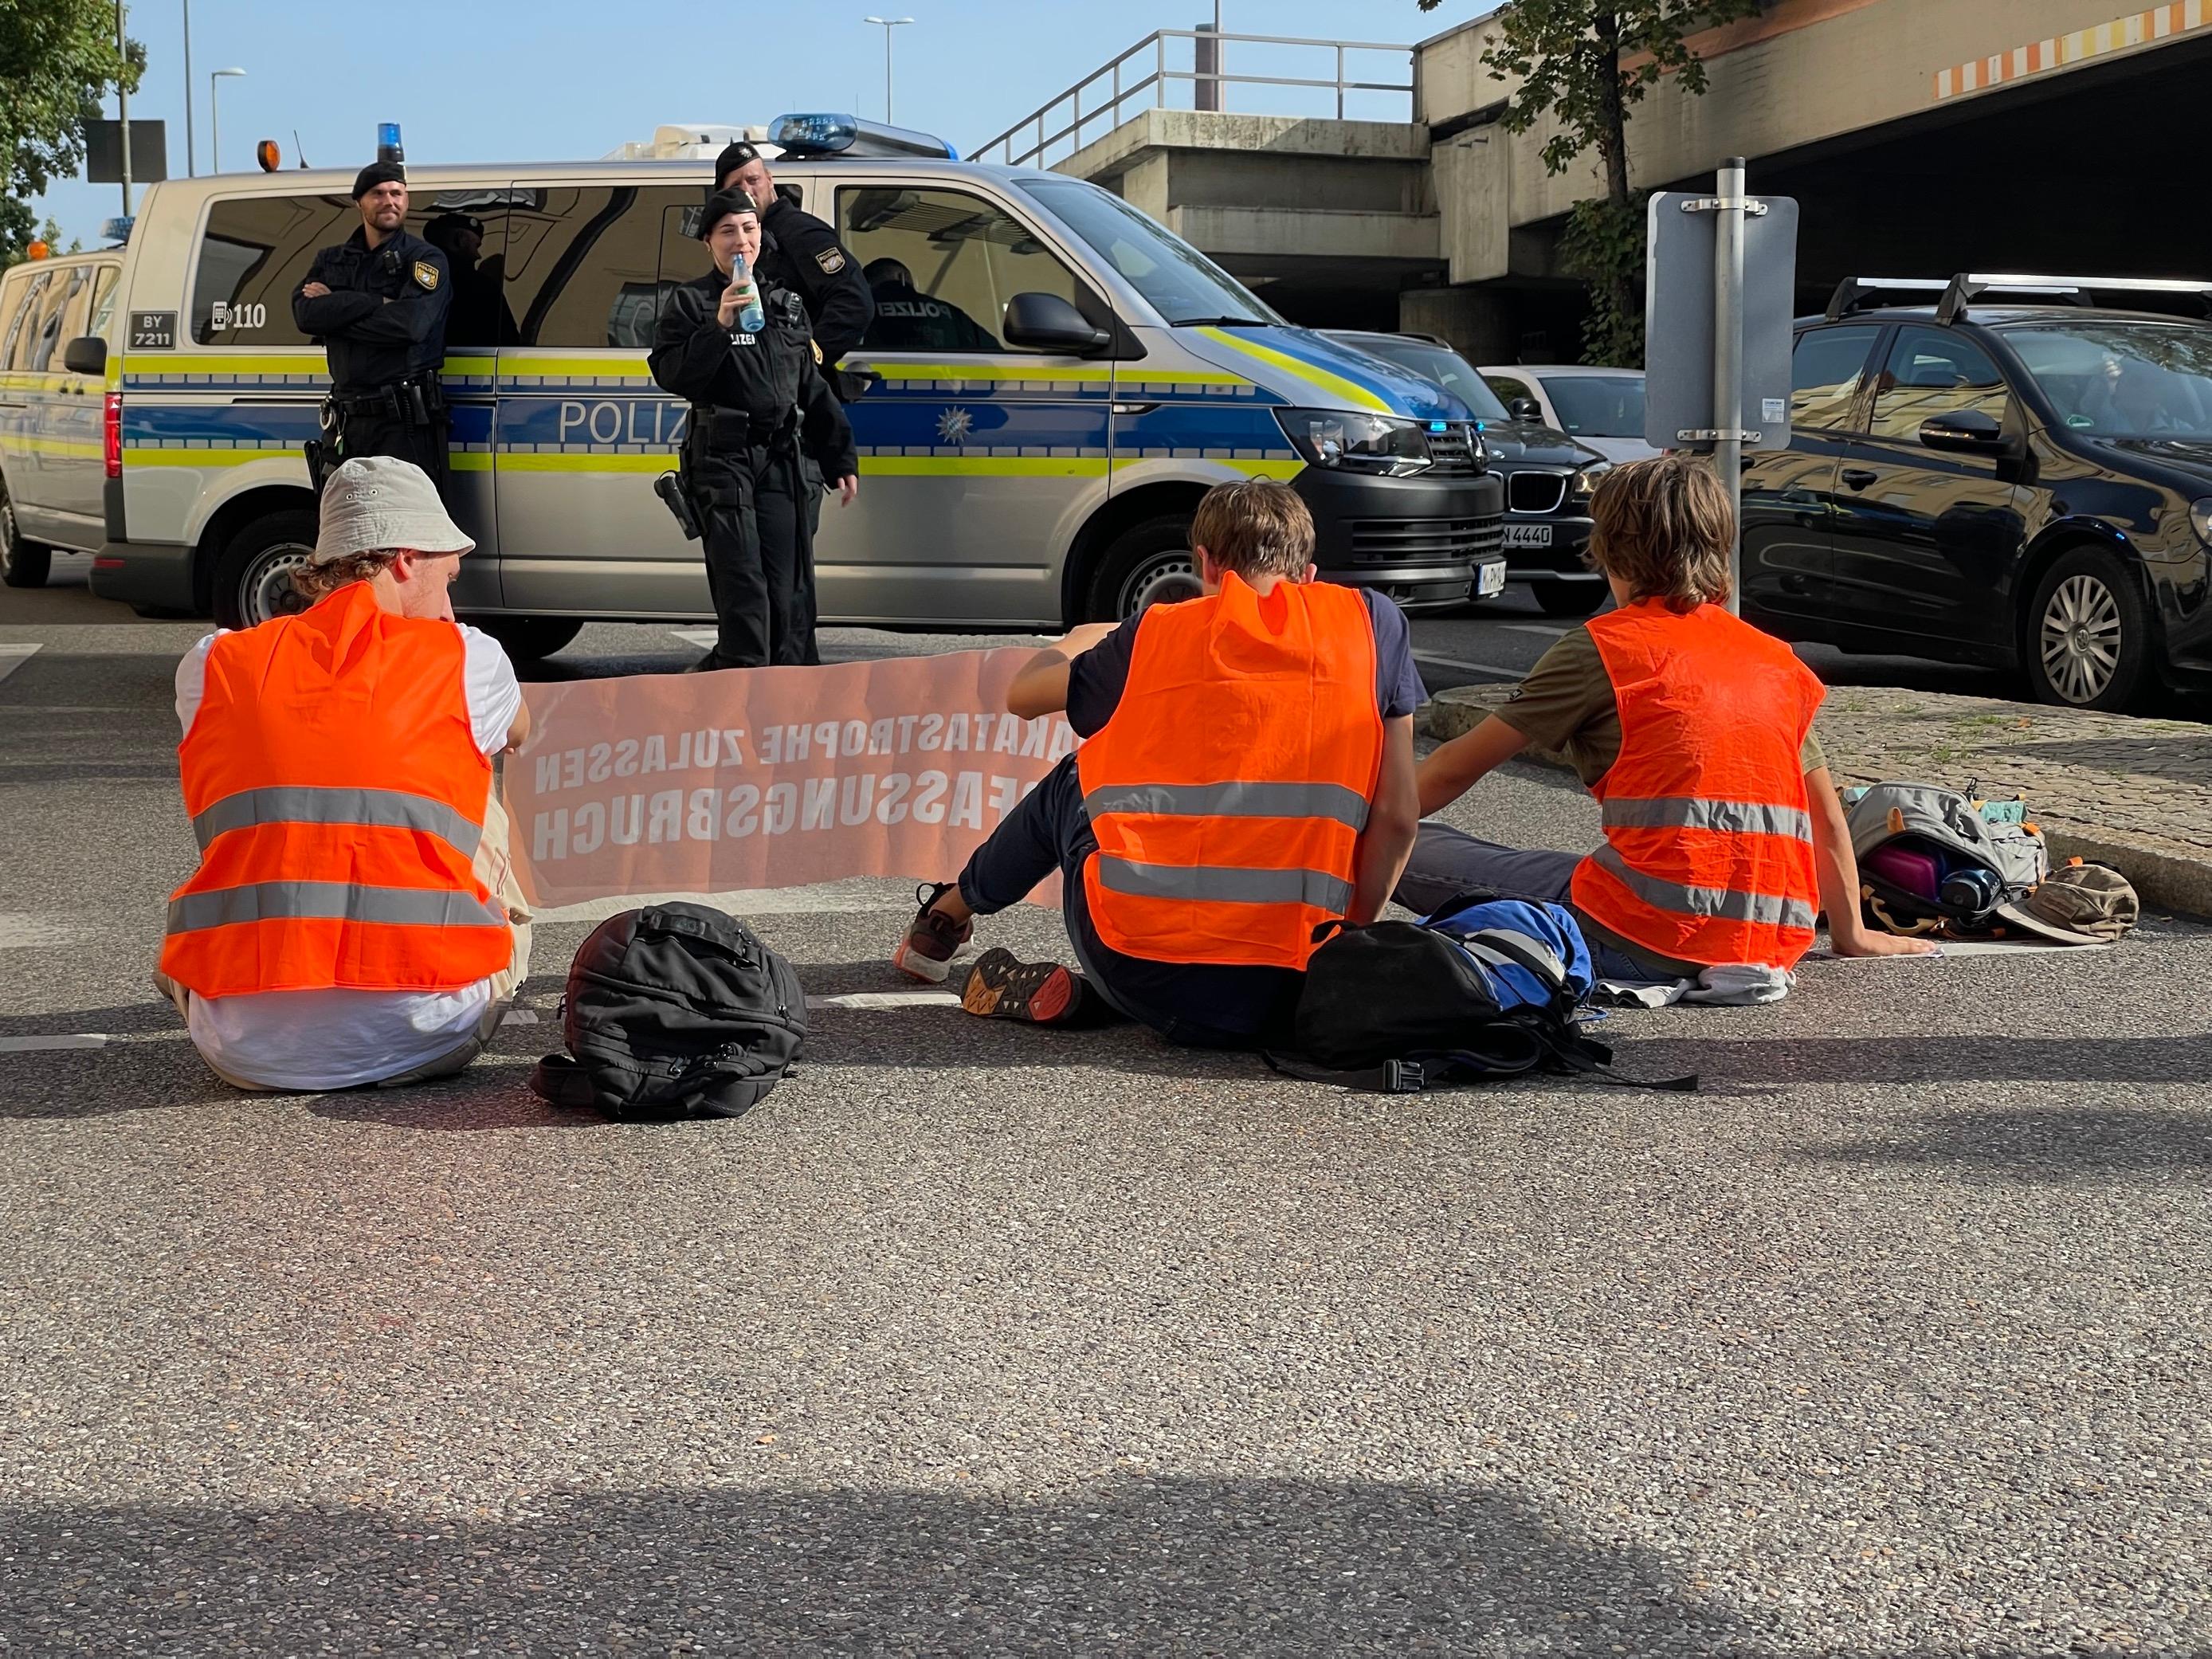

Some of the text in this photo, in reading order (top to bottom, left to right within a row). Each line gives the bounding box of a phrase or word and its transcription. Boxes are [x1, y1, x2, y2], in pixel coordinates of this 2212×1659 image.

[233, 303, 266, 327] 110
[143, 316, 163, 328] BY
[135, 333, 170, 345] 7211
[730, 333, 755, 345] LIZEI
[559, 401, 692, 444] POLIZ
[1513, 528, 1550, 543] 4440
